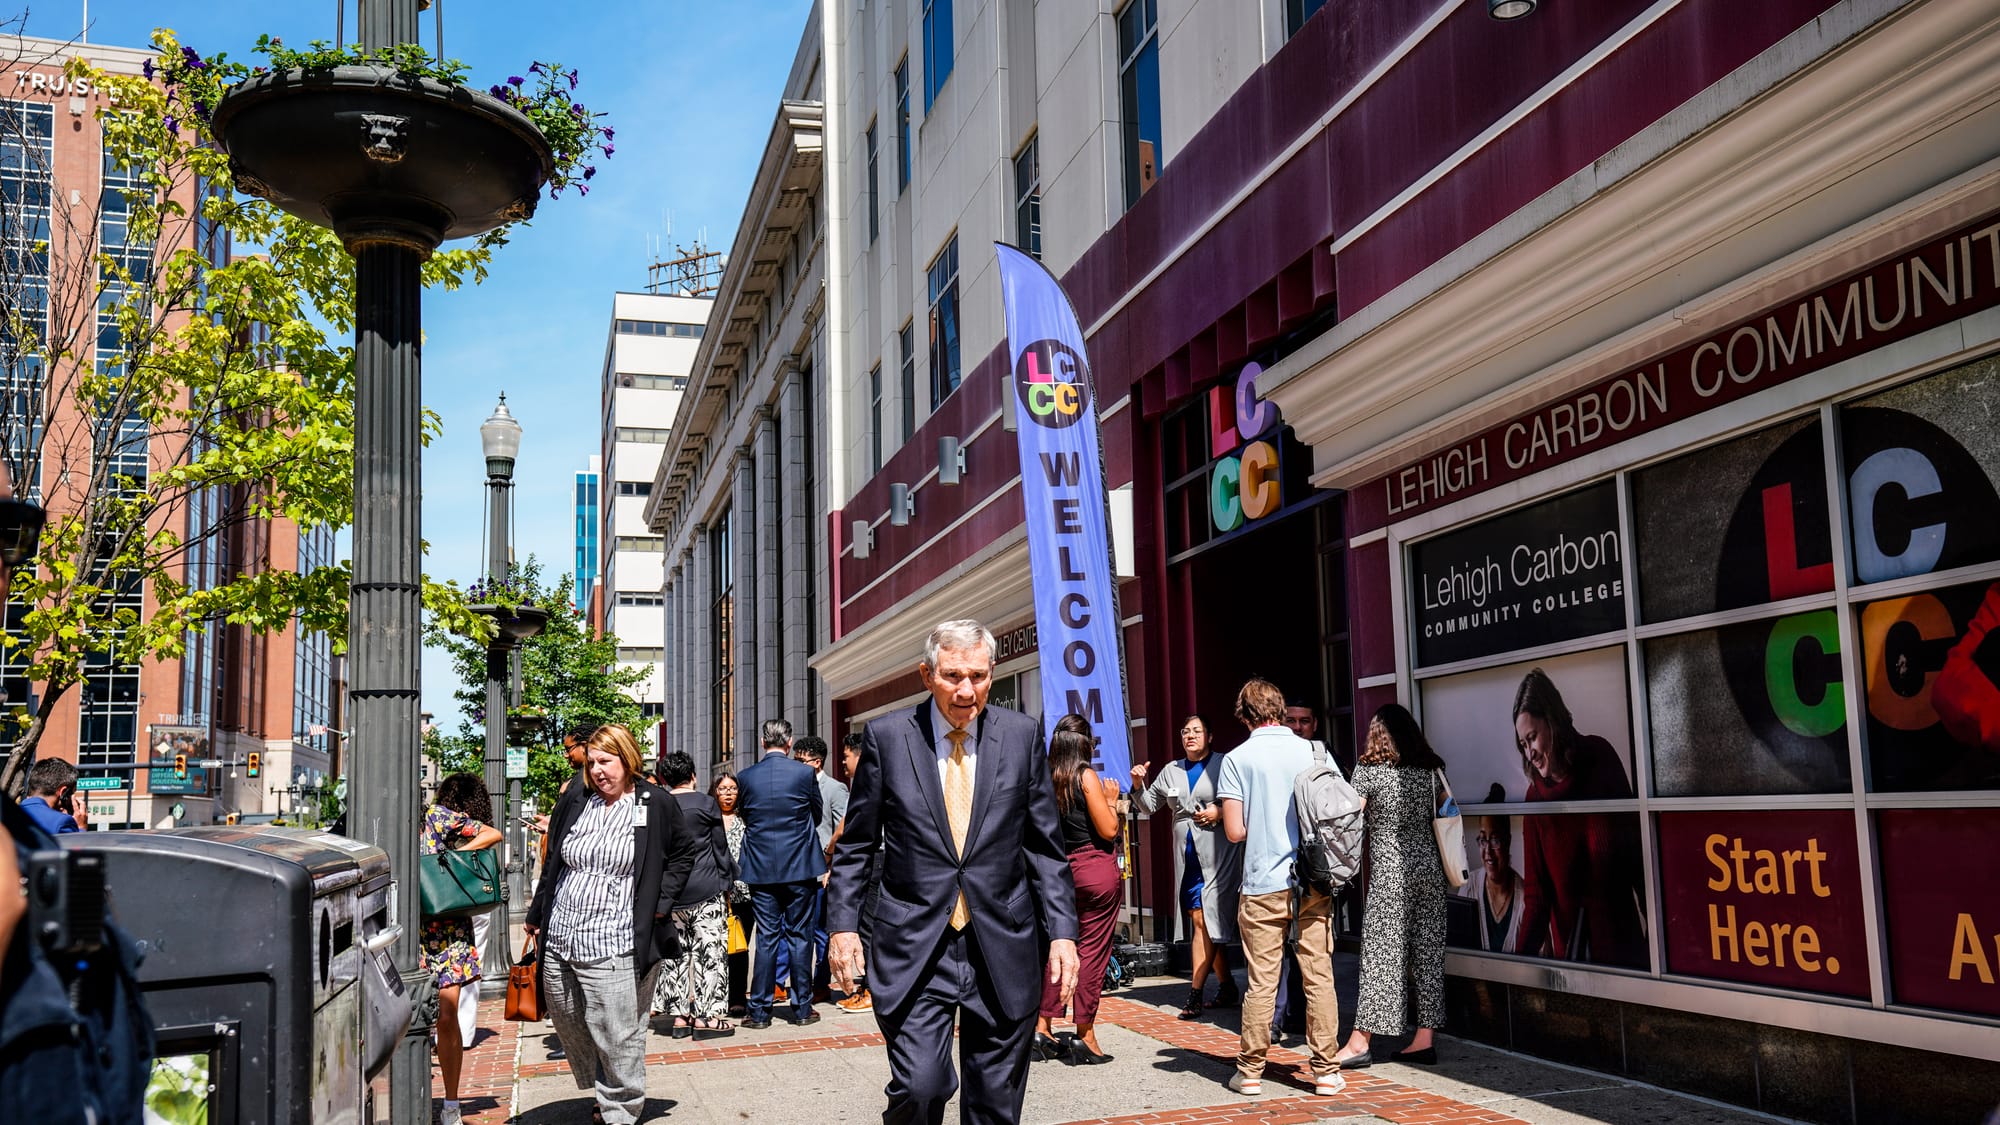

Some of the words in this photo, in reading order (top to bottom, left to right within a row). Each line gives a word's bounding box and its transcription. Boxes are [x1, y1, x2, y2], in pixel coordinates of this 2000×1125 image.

[1386, 438, 1488, 516] LEHIGH
[1504, 363, 1667, 470] CARBON
[1424, 555, 1502, 608] Lehigh
[1511, 530, 1620, 587] Carbon
[995, 633, 1013, 658] NLEY
[1013, 623, 1037, 653] CENTE
[1039, 451, 1104, 772] WELCOME
[1425, 603, 1521, 638] COMMUNITY
[1533, 580, 1623, 614] COLLEGE
[77, 779, 106, 788] EVENTH
[88, 805, 115, 815] FEE
[1705, 833, 1831, 897] Start
[1708, 903, 1840, 975] Here.
[1949, 913, 2000, 984] A
